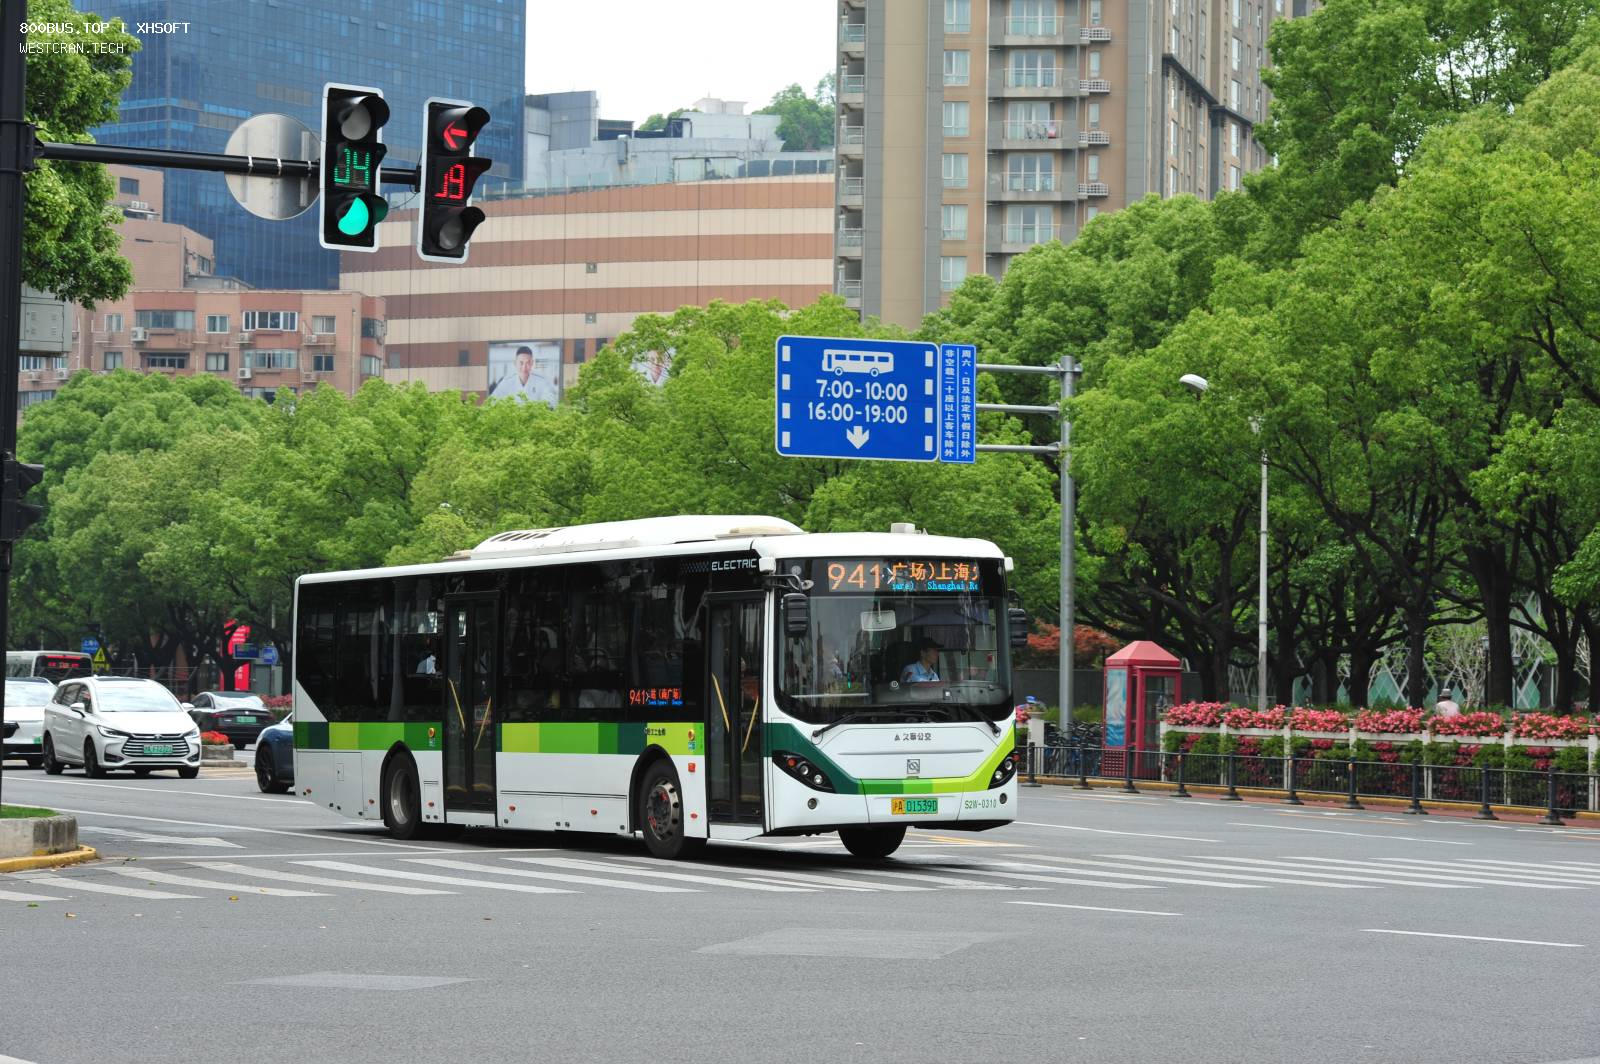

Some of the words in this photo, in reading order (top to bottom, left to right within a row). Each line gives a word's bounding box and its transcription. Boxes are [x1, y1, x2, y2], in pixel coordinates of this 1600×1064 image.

[816, 379, 908, 401] 7:00-10:00
[808, 402, 908, 424] 16:00-19:00
[711, 558, 757, 571] ELECTRIC
[828, 561, 881, 590] 941
[629, 690, 645, 704] 941
[965, 799, 997, 809] S2W-0310
